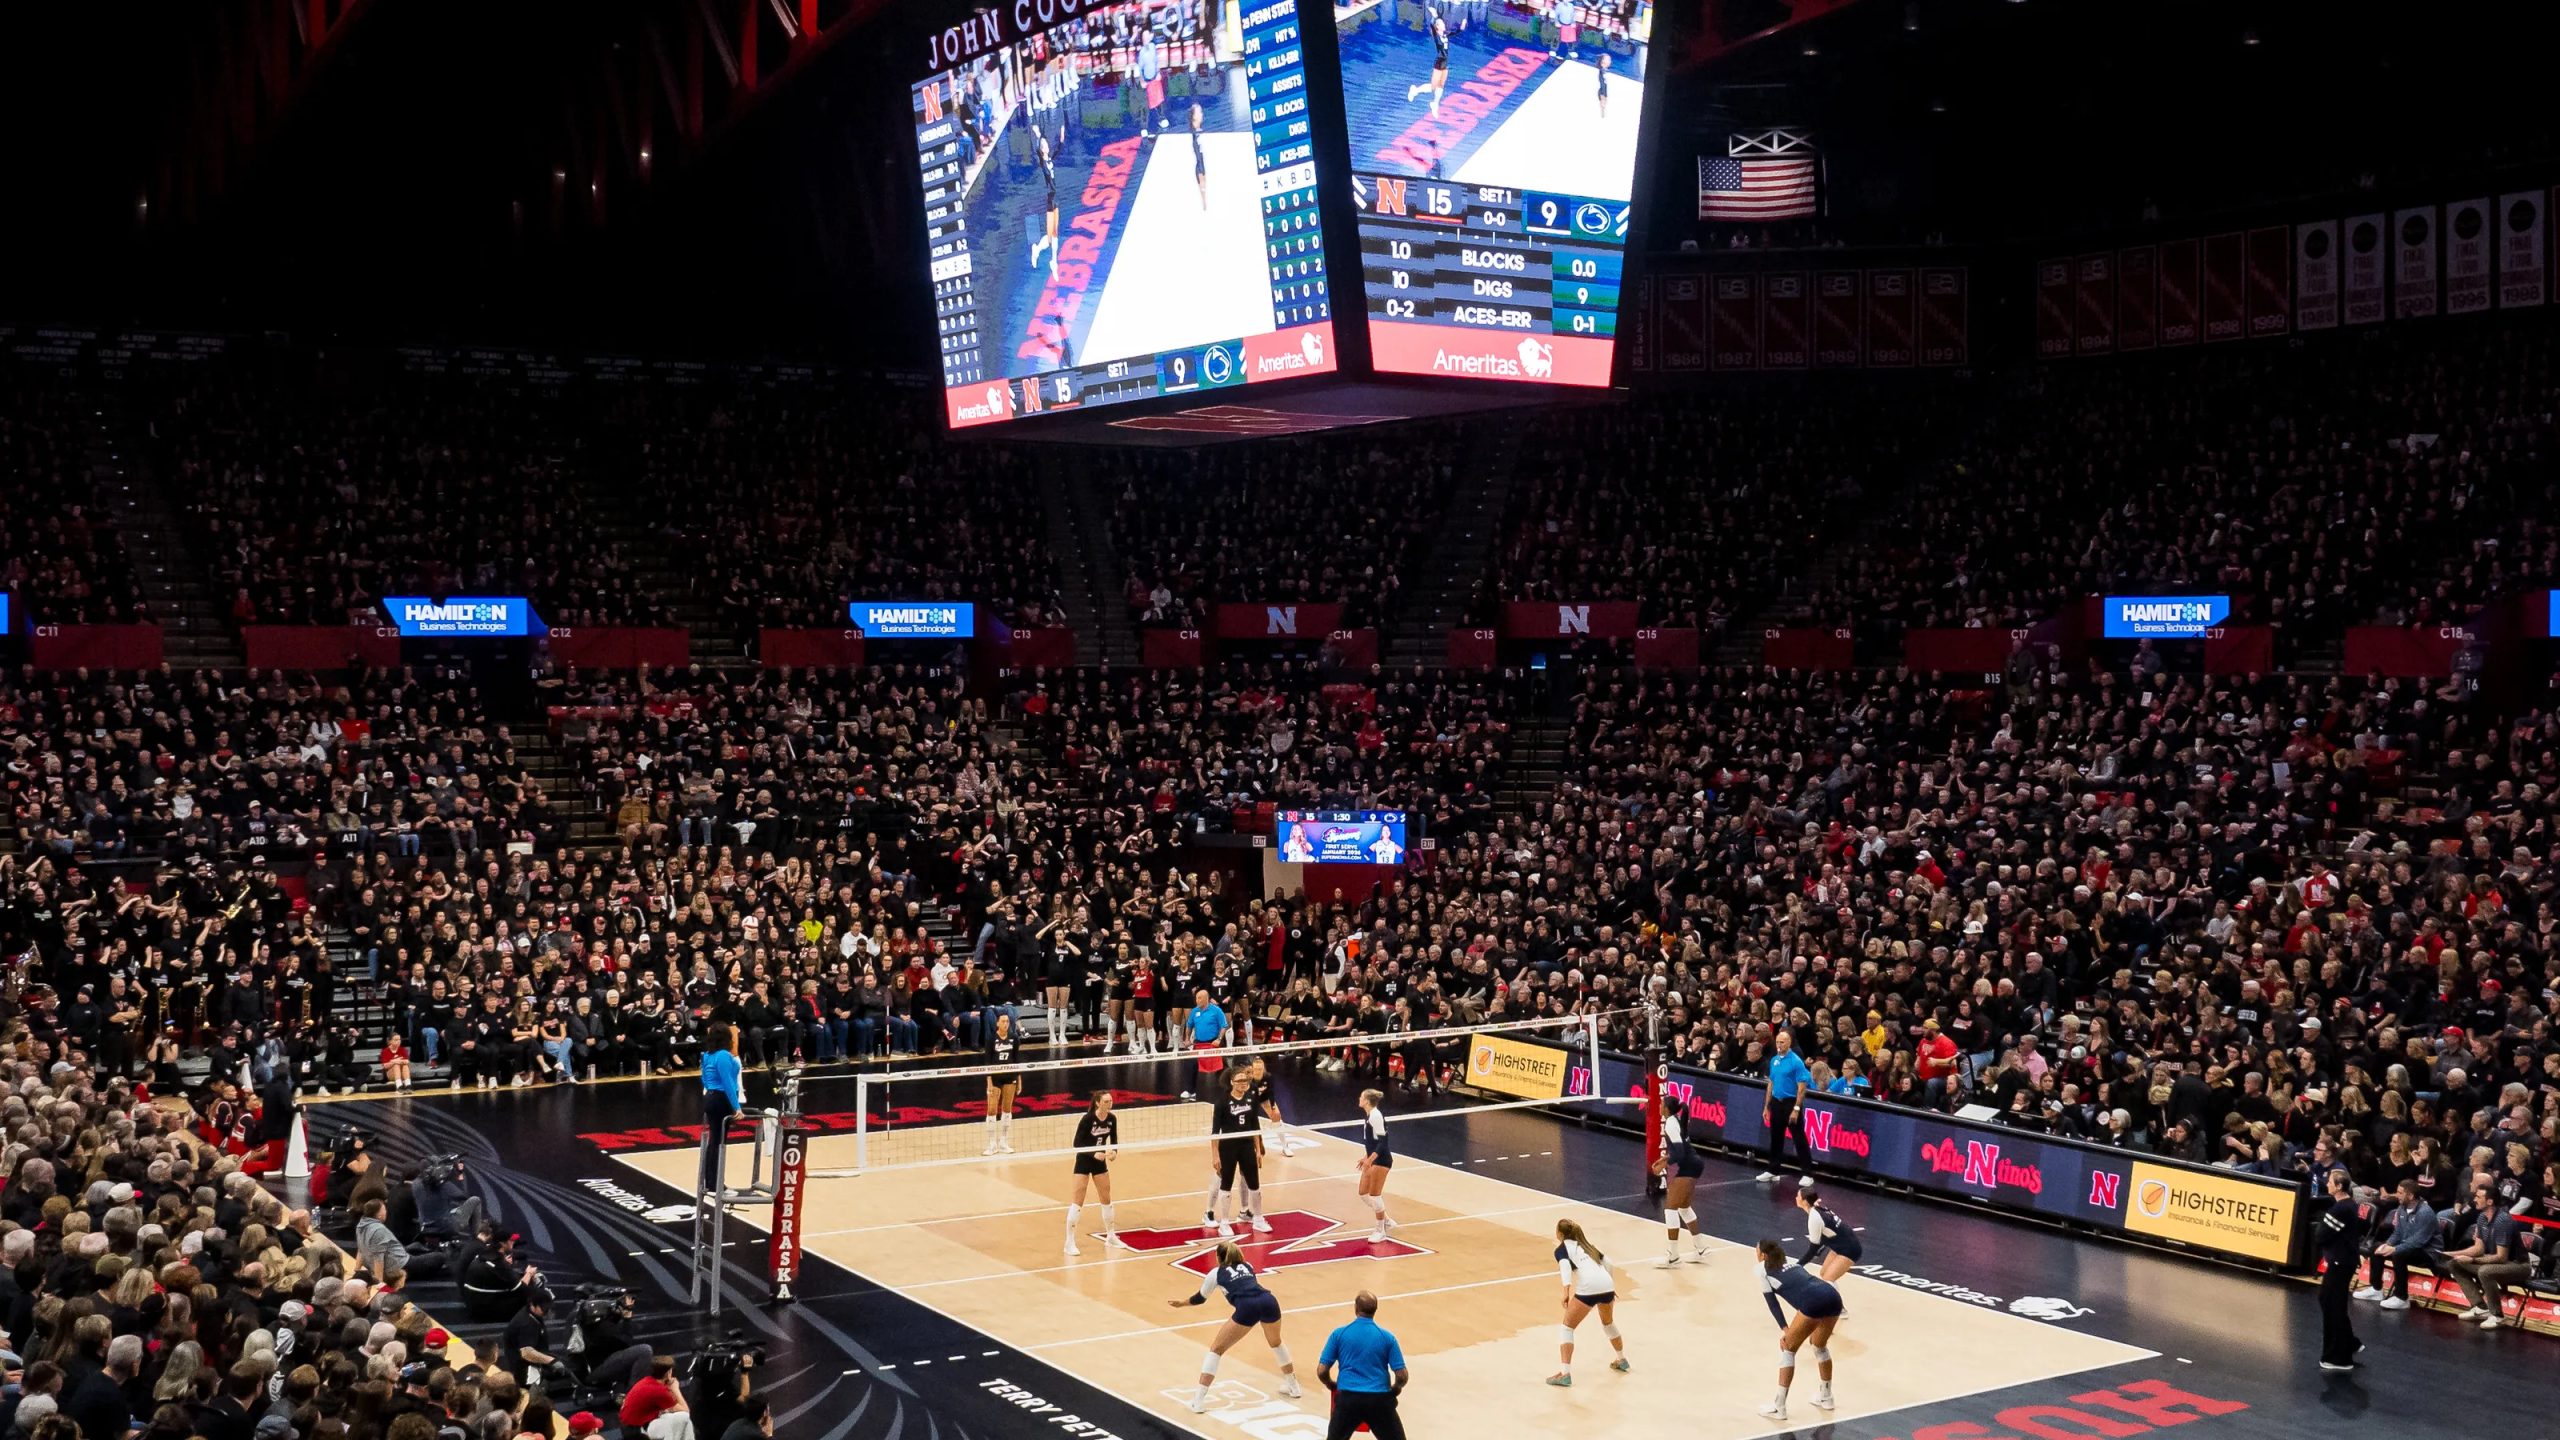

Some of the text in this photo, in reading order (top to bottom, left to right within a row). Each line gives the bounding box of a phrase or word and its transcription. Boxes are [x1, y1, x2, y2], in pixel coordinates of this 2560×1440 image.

[1249, 7, 1271, 27] PENN
[1271, 1, 1296, 21] STATE
[929, 9, 1001, 69] JOHN
[1275, 28, 1288, 43] HIT
[1272, 74, 1302, 94] ASSISTS
[1252, 98, 1305, 124] 0.0 BLOCKS
[1289, 121, 1308, 137] DIGS
[1280, 145, 1310, 163] ACES-ERR
[1276, 168, 1311, 187] K B D
[1279, 197, 1286, 210] 0
[1292, 193, 1300, 207] 0
[1307, 189, 1314, 203] 4
[1376, 177, 1452, 216] N 15
[1479, 188, 1512, 204] SET 1
[1483, 211, 1506, 227] 0-0
[1541, 201, 1557, 226] 9
[1267, 212, 1317, 236] 7 0 0 0
[1284, 241, 1290, 255] 1
[1297, 238, 1305, 252] 0
[1312, 235, 1319, 249] 0
[1286, 264, 1294, 278] 0
[1300, 261, 1307, 275] 0
[1315, 258, 1322, 272] 2
[1390, 240, 1597, 278] 1.0 BLOCKS 0.0
[1289, 286, 1295, 300] 1
[1302, 284, 1310, 298] 0
[1317, 281, 1325, 295] 0
[1392, 271, 1589, 305] 10 DIGS 9
[1292, 308, 1298, 322] 1
[1305, 306, 1313, 319] 0
[1320, 303, 1327, 317] 2
[1386, 299, 1595, 333] 0-2 ACES-ERR 0-1
[1107, 363, 1124, 379] SET
[1173, 361, 1186, 384] 9
[1055, 378, 1071, 404] 15
[420, 622, 455, 631] Business
[881, 625, 912, 633] Business
[1267, 606, 1297, 634] N
[1558, 605, 1590, 634] N
[2134, 623, 2165, 632] Business
[36, 626, 59, 637] C11
[376, 627, 399, 638] C12
[550, 627, 572, 638] C12
[1013, 630, 1031, 639] C13
[1179, 630, 1199, 640] C14
[1333, 630, 1353, 640] C14
[1474, 630, 1494, 640] C15
[1636, 630, 1656, 639] C15
[1765, 629, 1780, 639] C16
[1835, 629, 1851, 639] C16
[2011, 629, 2028, 640] C17
[2205, 629, 2225, 639] C17
[2440, 627, 2464, 639] C18
[839, 819, 852, 827] A11
[1306, 813, 1315, 821] 15
[249, 836, 265, 845] A10
[999, 1053, 1009, 1061] 27
[1493, 1052, 1557, 1078] HIGHSTREET
[1569, 1066, 1590, 1096] N
[1238, 1115, 1246, 1125] 5
[577, 1178, 654, 1211] Ameritas
[2089, 1170, 2120, 1209] N
[2170, 1188, 2279, 1226] HIGHSTREET
[776, 1170, 798, 1299] NEBRASKA
[2168, 1211, 2204, 1226] Insurance
[2212, 1220, 2246, 1234] Financial
[2248, 1227, 2279, 1242] Services
[1226, 1263, 1250, 1278] 14
[1849, 1264, 2003, 1307] Ameritas
[979, 1378, 1063, 1413] TERRY
